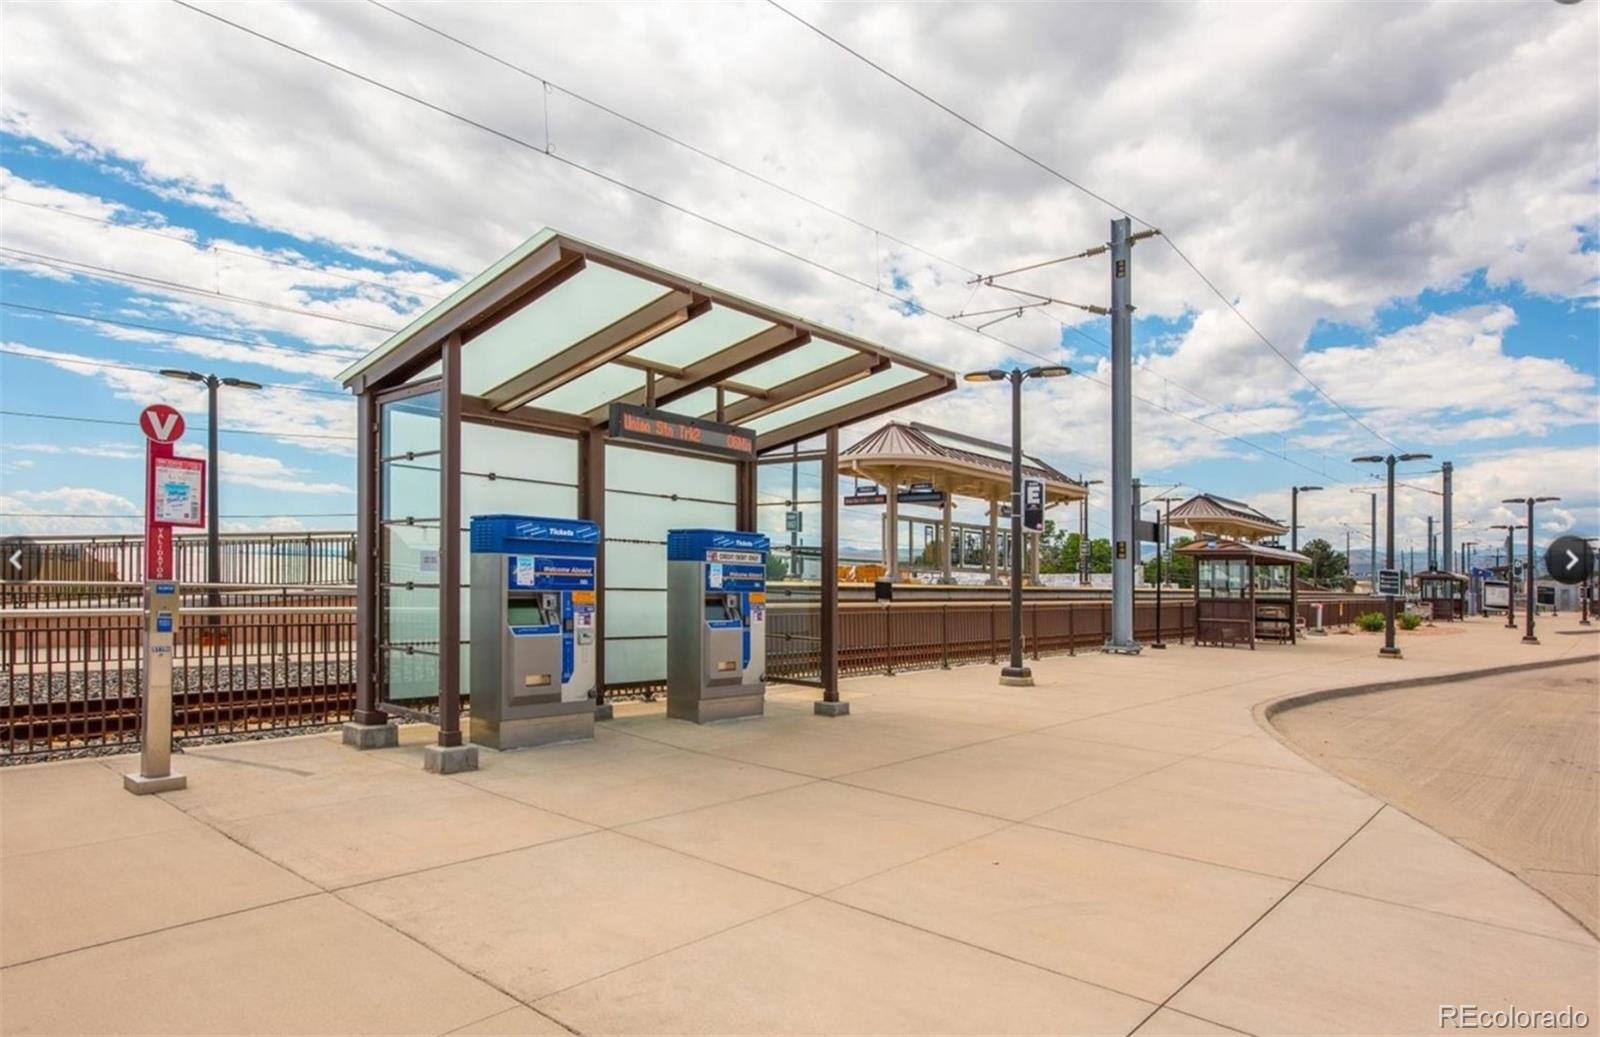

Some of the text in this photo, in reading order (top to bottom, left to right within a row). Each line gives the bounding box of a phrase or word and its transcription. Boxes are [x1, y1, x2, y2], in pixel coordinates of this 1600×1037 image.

[146, 410, 179, 441] V
[623, 412, 650, 433] Union
[1027, 486, 1041, 504] E
[549, 527, 575, 537] Tickets
[156, 527, 165, 578] VALIDATOR
